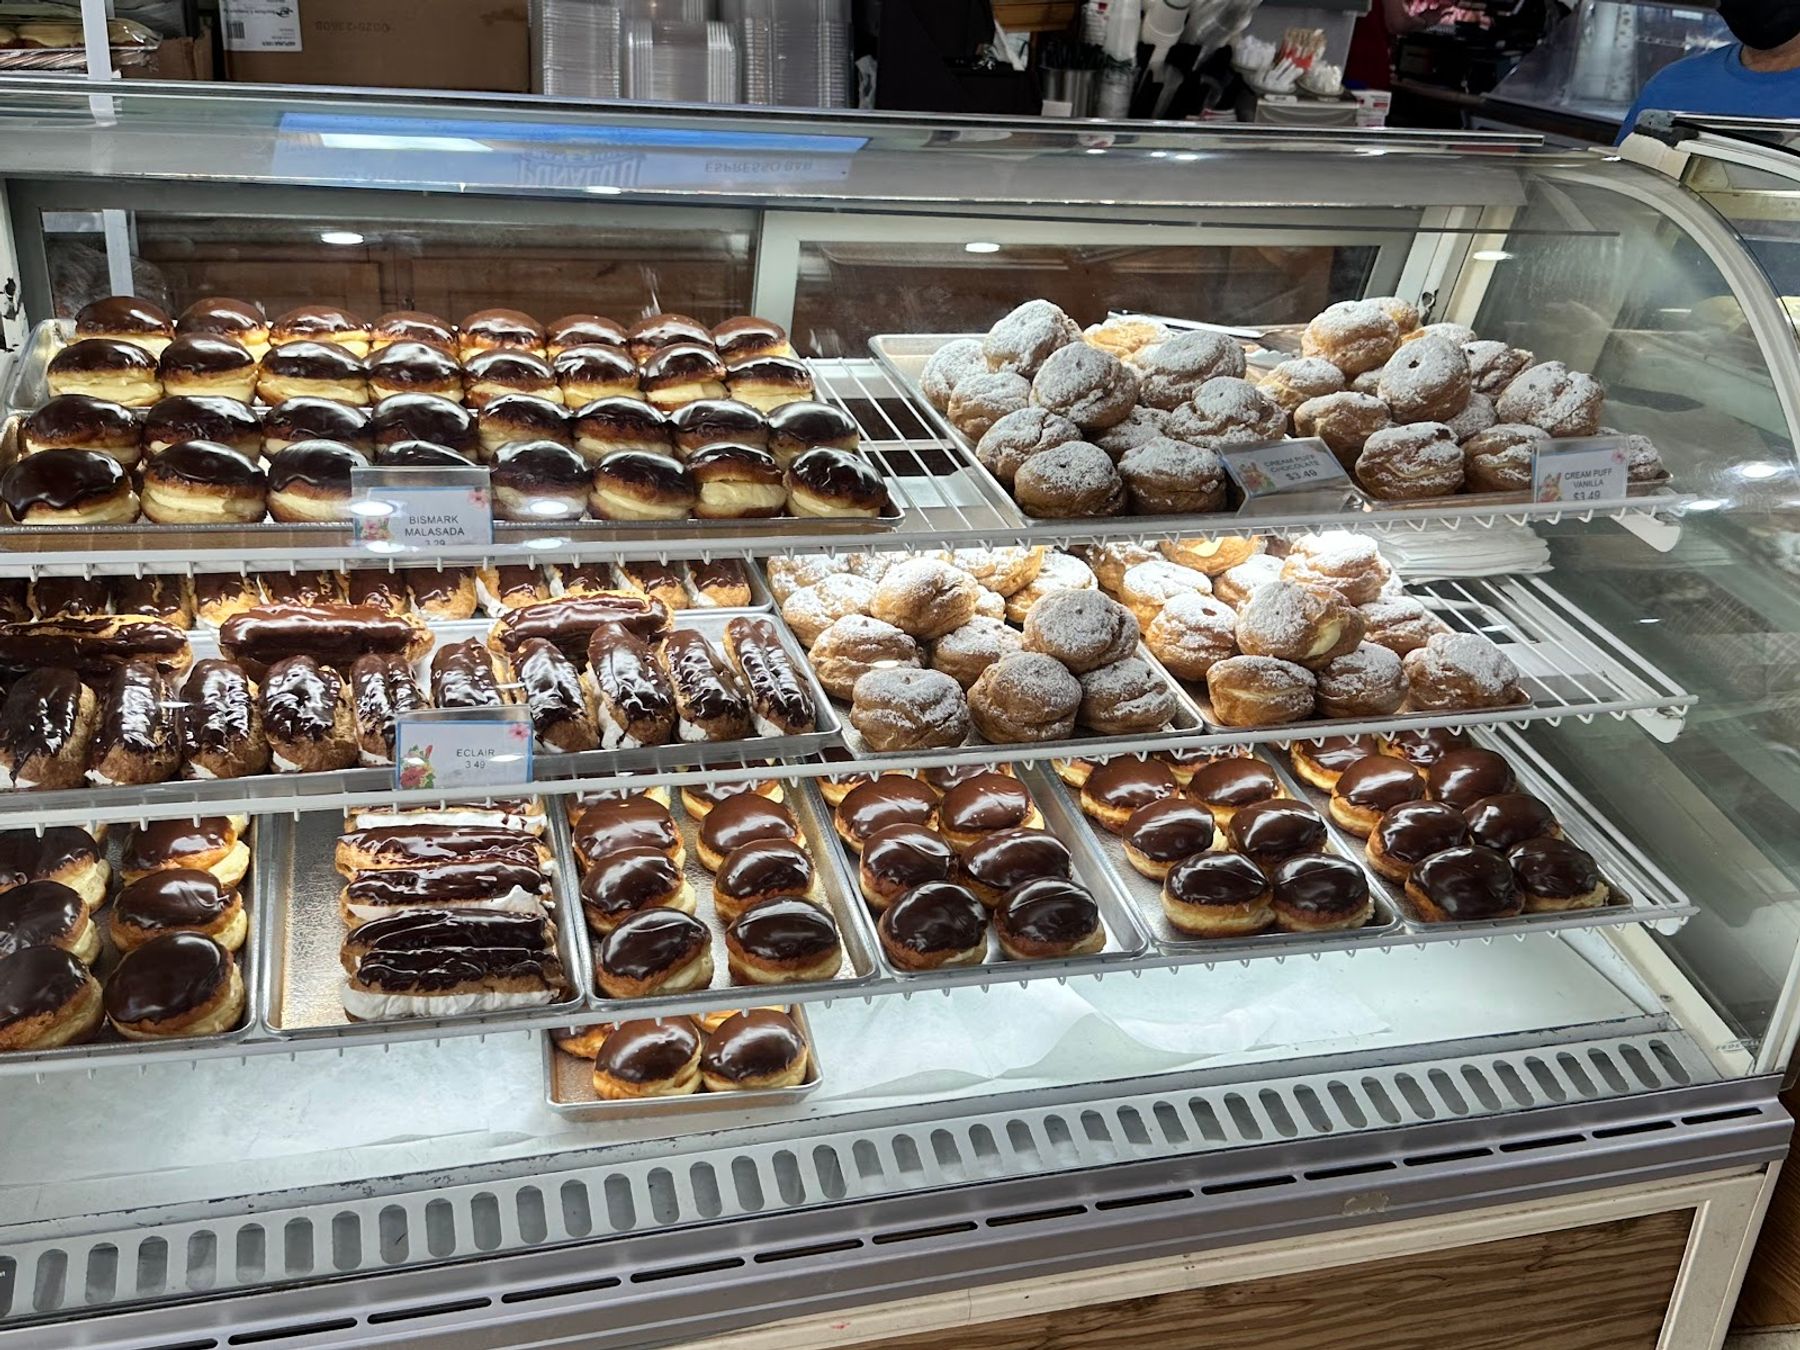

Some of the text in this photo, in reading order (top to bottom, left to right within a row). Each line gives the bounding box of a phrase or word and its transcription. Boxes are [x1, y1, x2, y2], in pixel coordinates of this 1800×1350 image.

[1264, 454, 1315, 467] CREAM PUFF
[1269, 460, 1320, 473] CHOCOLATE
[1564, 468, 1612, 480] CREAM PUFF
[1573, 479, 1604, 489] VANILLA
[409, 515, 459, 525] BISMARK
[404, 527, 465, 537] MALASADA
[456, 748, 496, 758] ECLAIR
